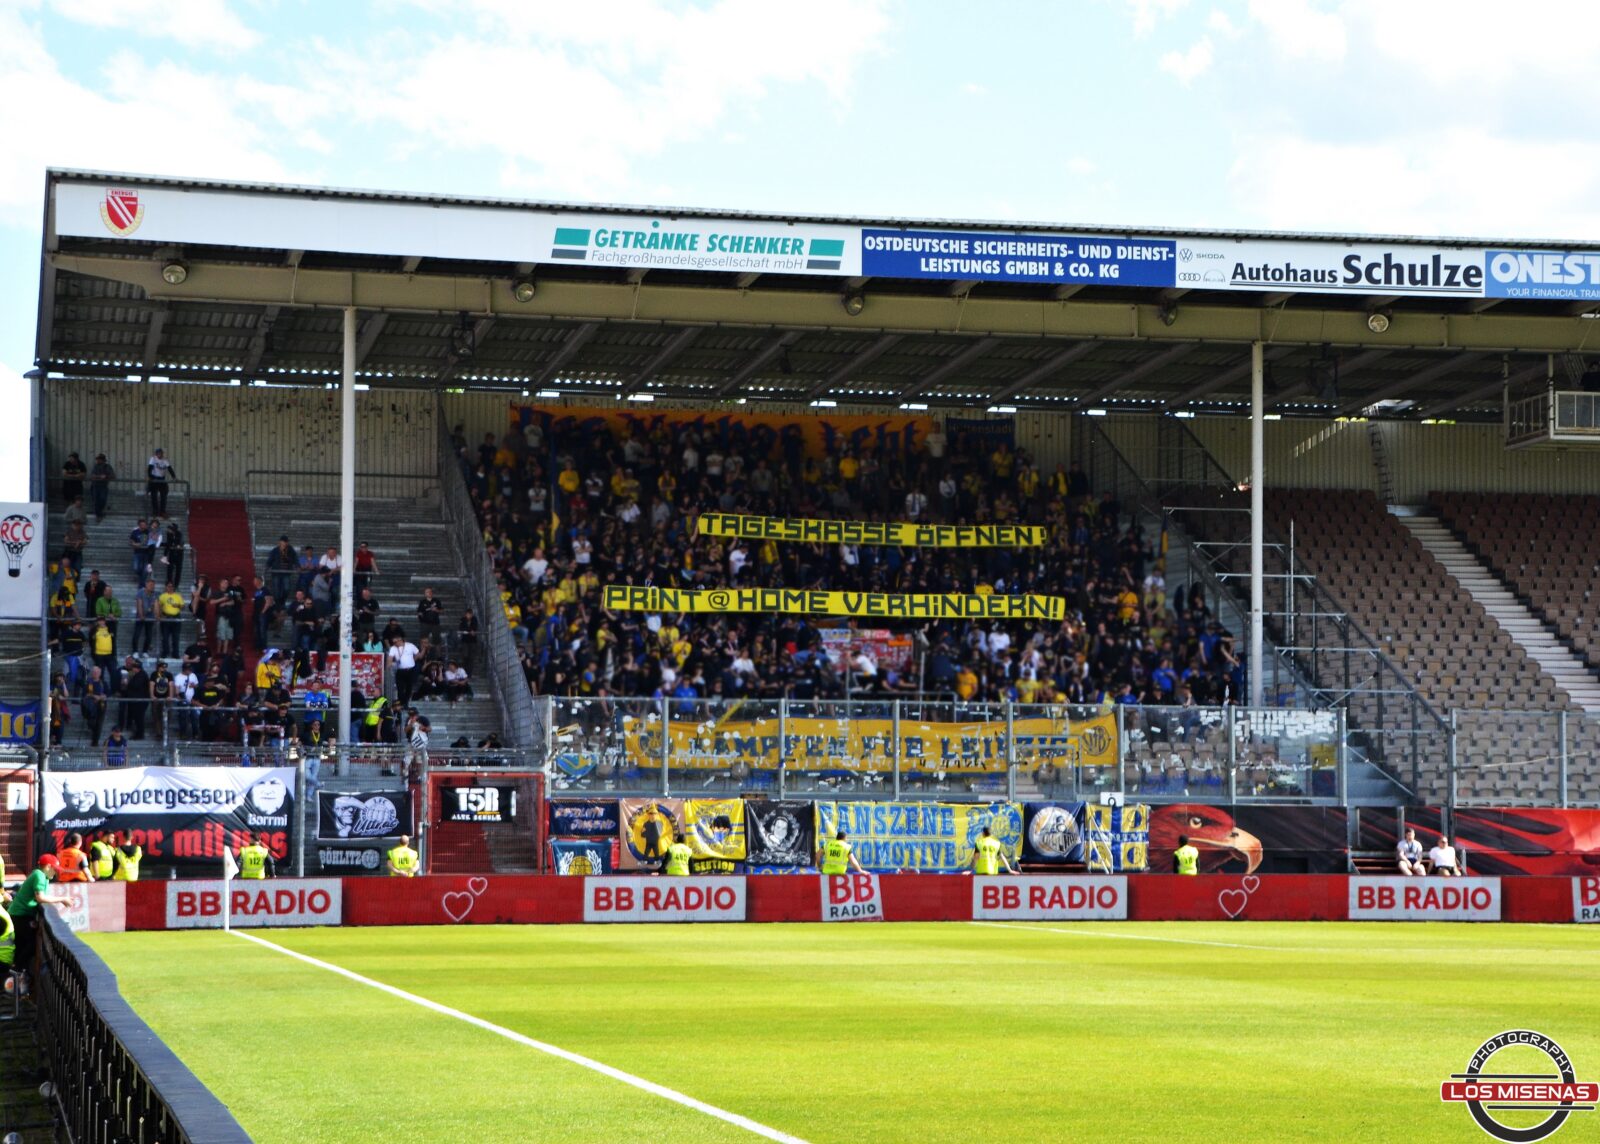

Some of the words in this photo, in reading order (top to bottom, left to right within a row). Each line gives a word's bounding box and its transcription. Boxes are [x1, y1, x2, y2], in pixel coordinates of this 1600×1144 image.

[707, 234, 804, 256] SCHENKER
[864, 236, 968, 255] OSTDEUTSCHE
[974, 240, 1073, 258] SICHERHEITS-
[1079, 245, 1111, 259] UND
[1116, 245, 1174, 262] DIENST-
[591, 250, 769, 269] Fachgroßhandelsgesellschaft
[773, 258, 804, 270] mbH
[920, 257, 1000, 275] LEISTUNGS
[1005, 260, 1050, 277] GMBH
[1054, 262, 1065, 277] &
[1068, 263, 1094, 278] CO.
[1099, 264, 1120, 279] KG
[1230, 262, 1338, 284] Autohaus
[1342, 252, 1483, 288] Schulze
[1506, 288, 1530, 297] YOUR
[1532, 288, 1579, 298] FINANCIAL
[0, 521, 33, 543] RCC
[701, 514, 904, 544] TAGESKASSE
[819, 804, 955, 835] FANSZENE
[177, 892, 221, 917] BB
[231, 888, 332, 916] RADIO
[593, 887, 635, 911] BB
[643, 886, 737, 911] RADIO
[829, 874, 875, 905] BB
[982, 885, 1021, 910] BB
[1029, 884, 1119, 910] RADIO
[1358, 886, 1397, 910] BB
[1404, 885, 1492, 911] RADIO
[830, 904, 877, 919] RADIO
